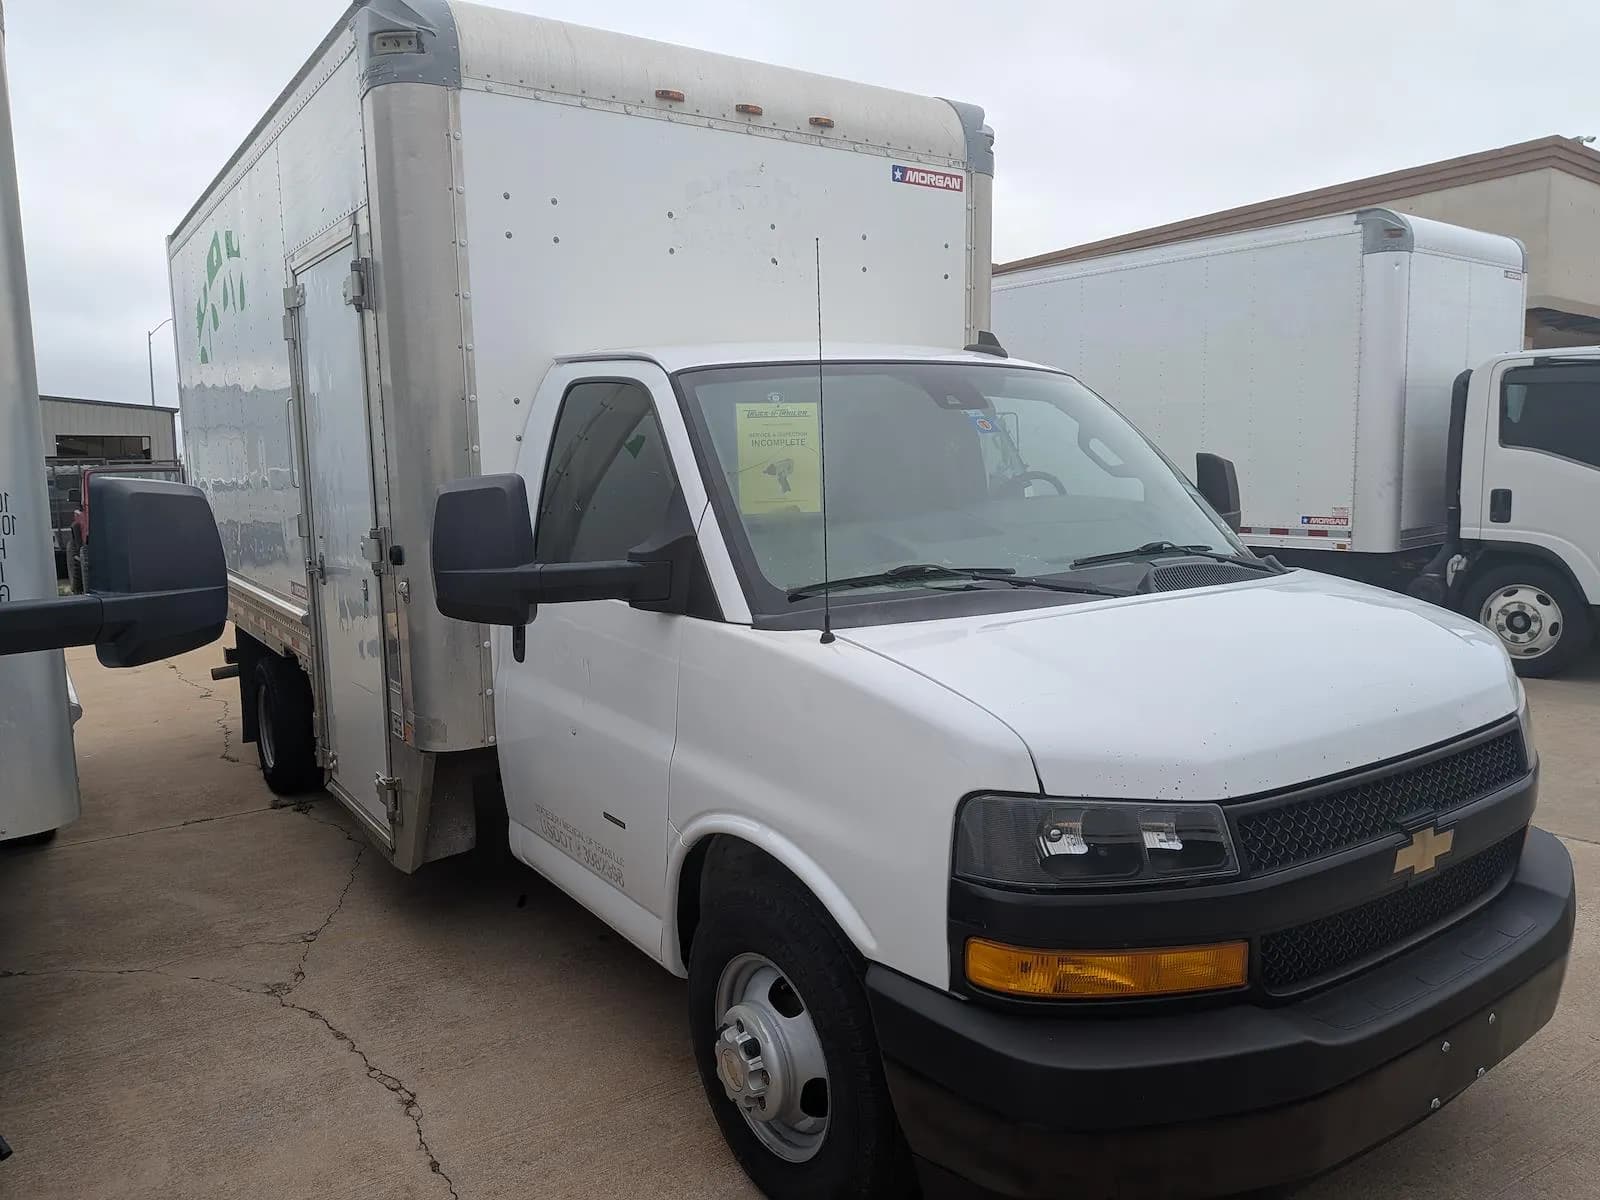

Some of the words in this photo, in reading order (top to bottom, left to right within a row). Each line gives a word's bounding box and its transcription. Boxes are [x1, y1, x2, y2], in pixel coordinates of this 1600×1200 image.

[905, 170, 962, 190] MORGAN
[751, 438, 806, 447] INCOMPLETE
[1309, 517, 1348, 525] MORGAN
